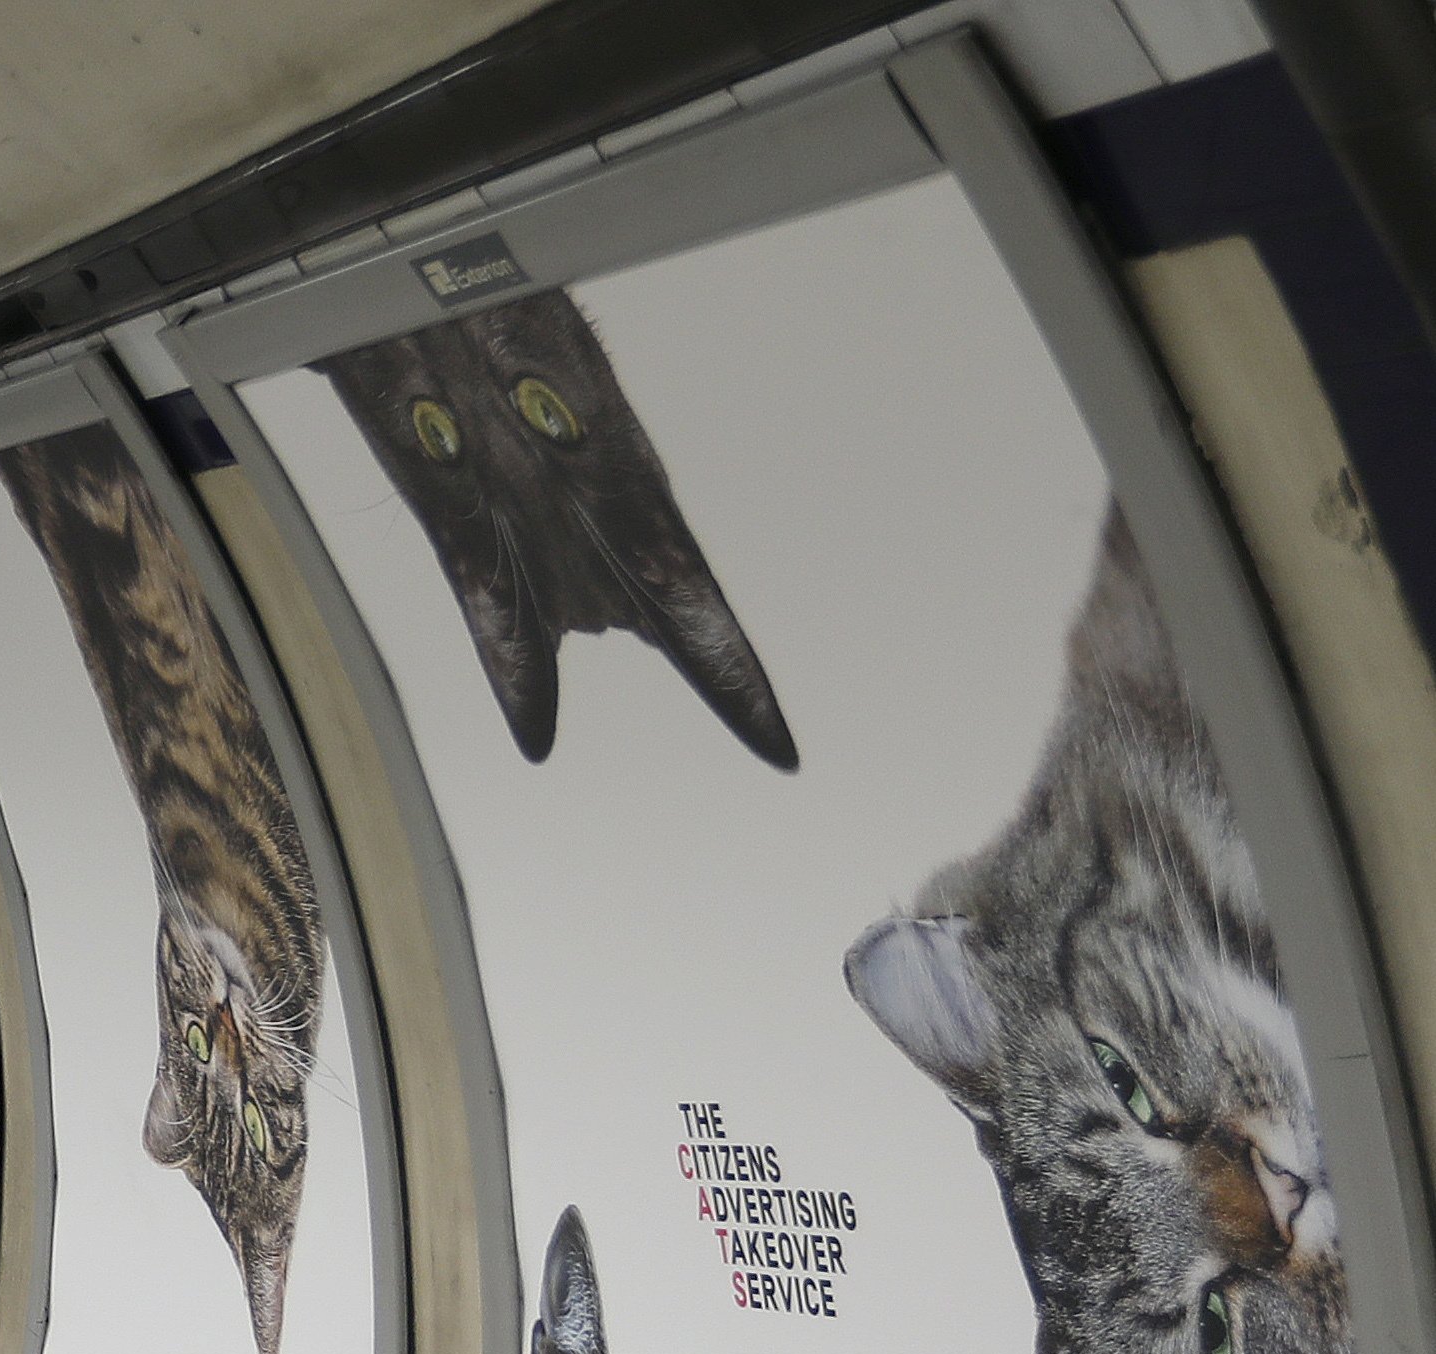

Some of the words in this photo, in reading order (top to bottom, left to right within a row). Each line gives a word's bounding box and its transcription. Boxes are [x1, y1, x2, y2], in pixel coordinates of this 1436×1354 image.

[678, 1103, 726, 1138] THE
[678, 1143, 781, 1182] CITIZENS
[698, 1186, 856, 1230] ADVERTISING
[714, 1228, 847, 1275] TAKEOVER
[732, 1270, 837, 1317] SERVICE
